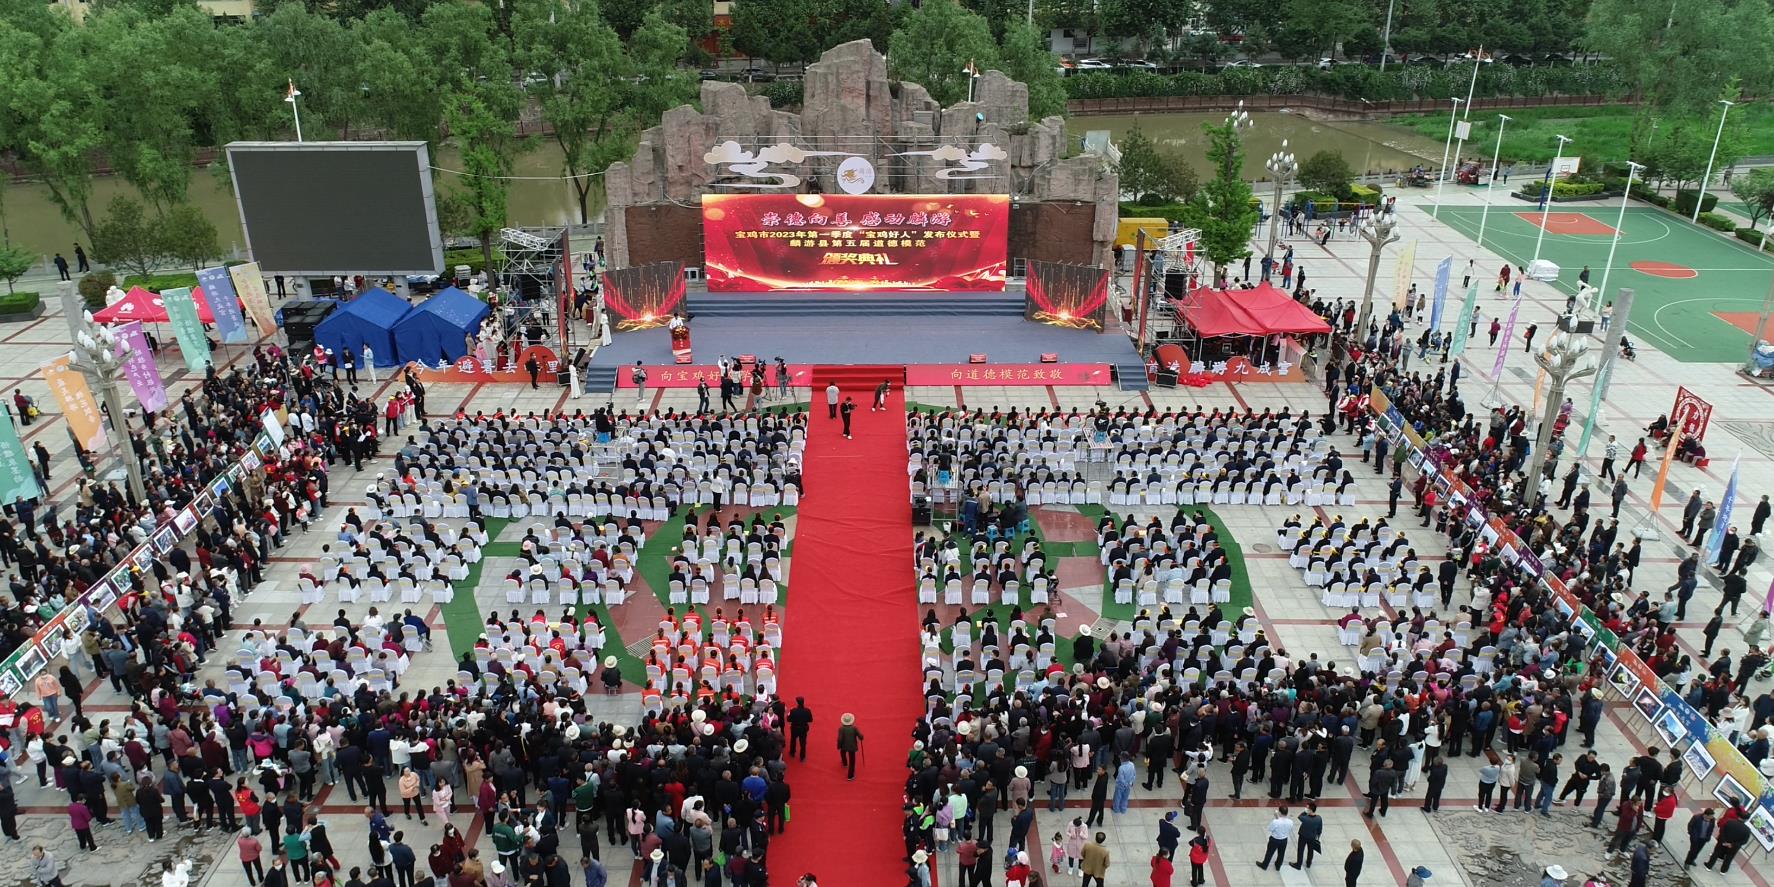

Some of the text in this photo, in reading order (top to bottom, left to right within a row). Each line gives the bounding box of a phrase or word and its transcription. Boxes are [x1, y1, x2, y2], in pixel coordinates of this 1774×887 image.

[789, 239, 926, 248] 麟游县第五届道德模范
[819, 252, 899, 265] 颁奖典礼
[414, 358, 560, 375] 今年避暑去里
[950, 369, 1064, 381] 向道德模范致敬
